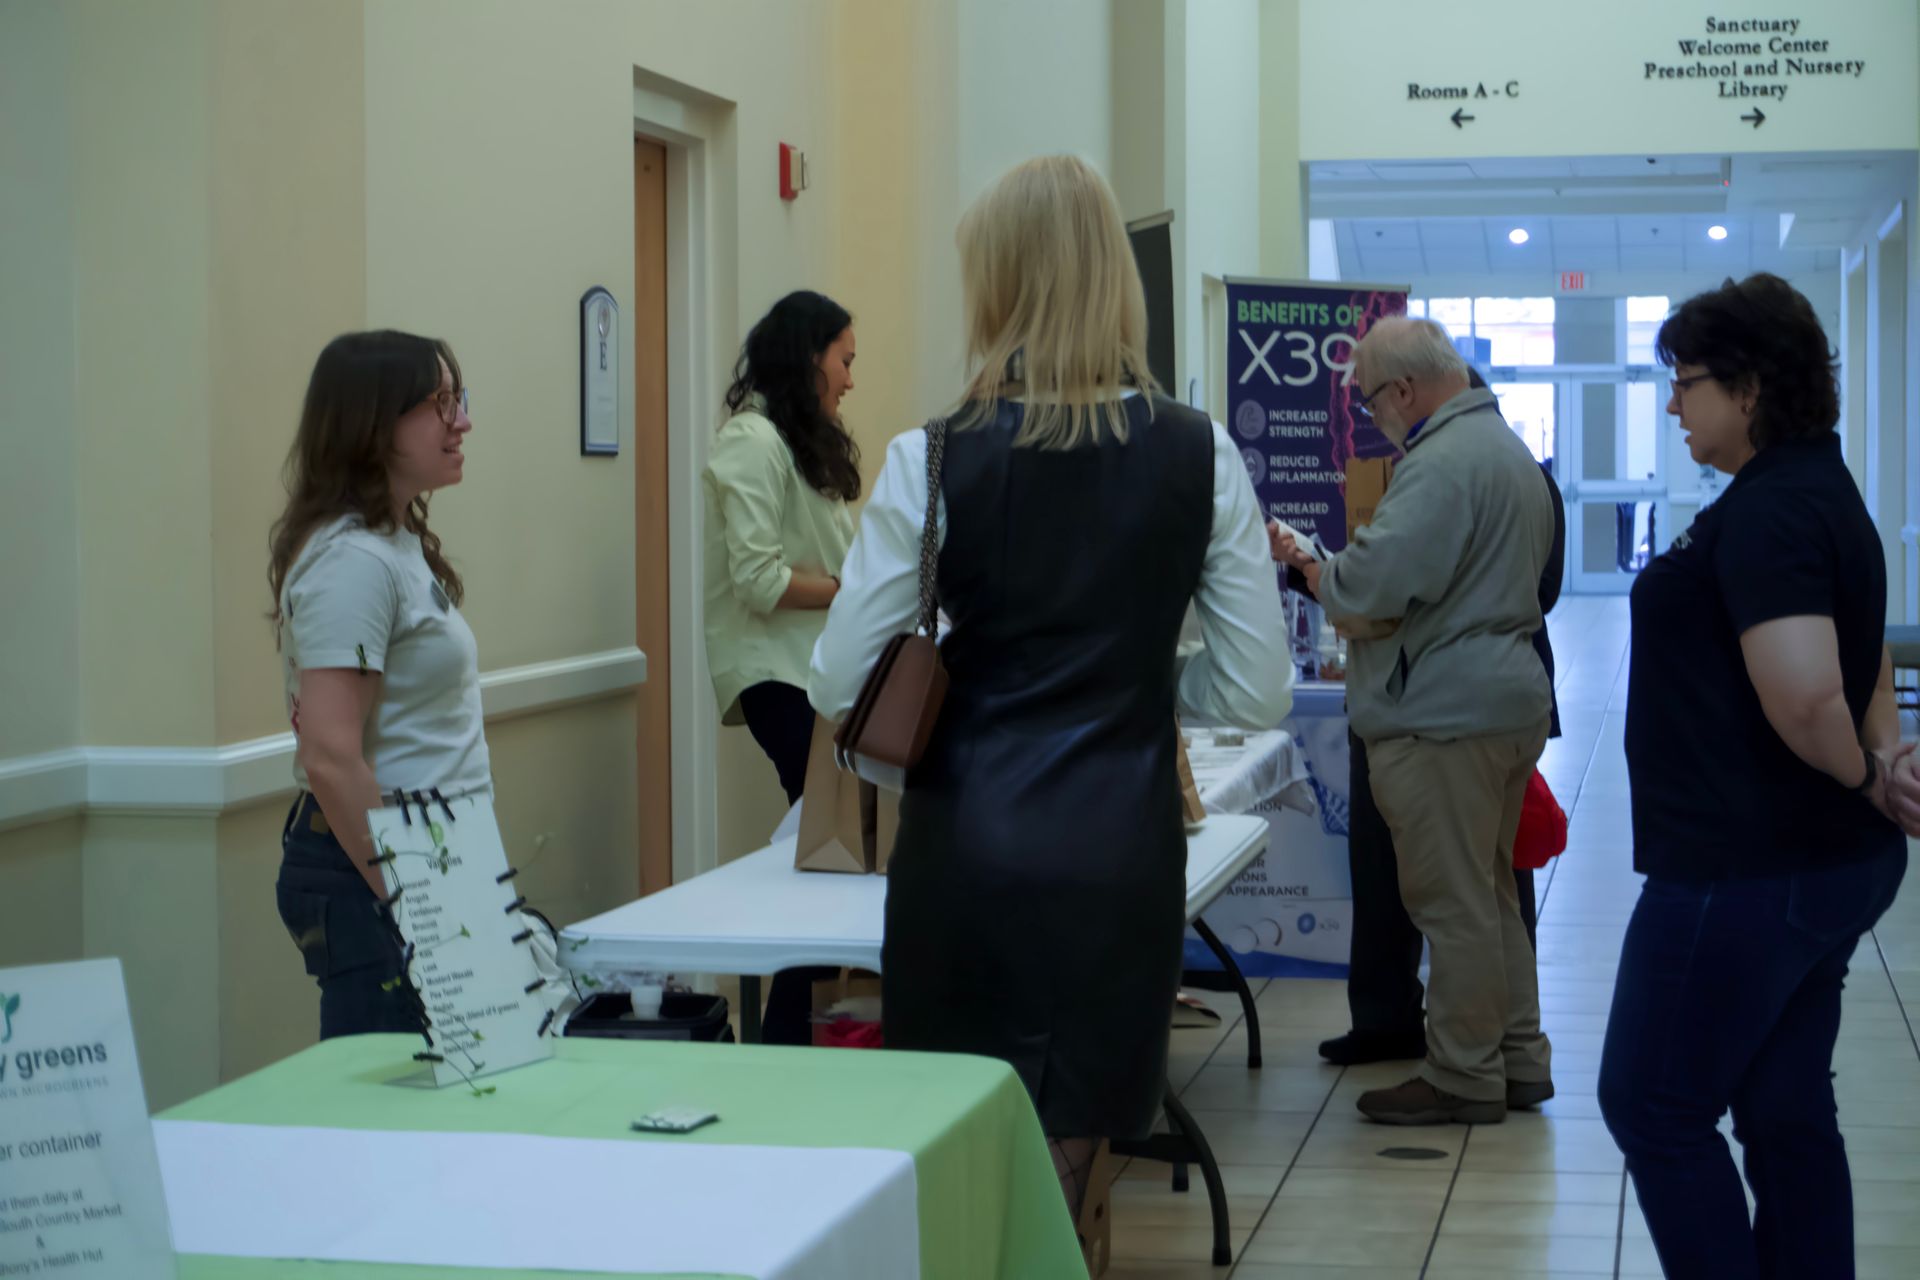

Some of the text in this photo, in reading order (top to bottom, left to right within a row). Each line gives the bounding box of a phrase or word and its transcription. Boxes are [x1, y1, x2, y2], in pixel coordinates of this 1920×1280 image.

[1705, 16, 1801, 36] Sanctuary
[1678, 37, 1830, 56] Welcome Center
[1644, 58, 1866, 79] Preschool and Nursery
[1407, 82, 1469, 100] Rooms
[1473, 81, 1488, 98] A
[1505, 80, 1519, 98] C
[1718, 81, 1788, 101] Library
[1561, 271, 1584, 289] EXIT
[1237, 300, 1364, 327] BENEFITS OF
[1238, 328, 1360, 387] X39
[1269, 410, 1328, 423] INCREASED
[1269, 426, 1324, 438] STRENGTH
[1270, 456, 1320, 468] REDUCED
[1270, 471, 1346, 485] INFLAMMATION
[1270, 503, 1329, 515] INCREASED
[1281, 517, 1316, 530] AMINA
[1226, 885, 1309, 897] APPEARANCE
[16, 1042, 107, 1080] greens
[19, 1130, 103, 1159] container
[10, 1194, 40, 1211] them
[42, 1188, 69, 1205] daily
[72, 1186, 84, 1201] at
[35, 1209, 81, 1229] Country
[83, 1203, 122, 1221] Market
[36, 1234, 45, 1249] &
